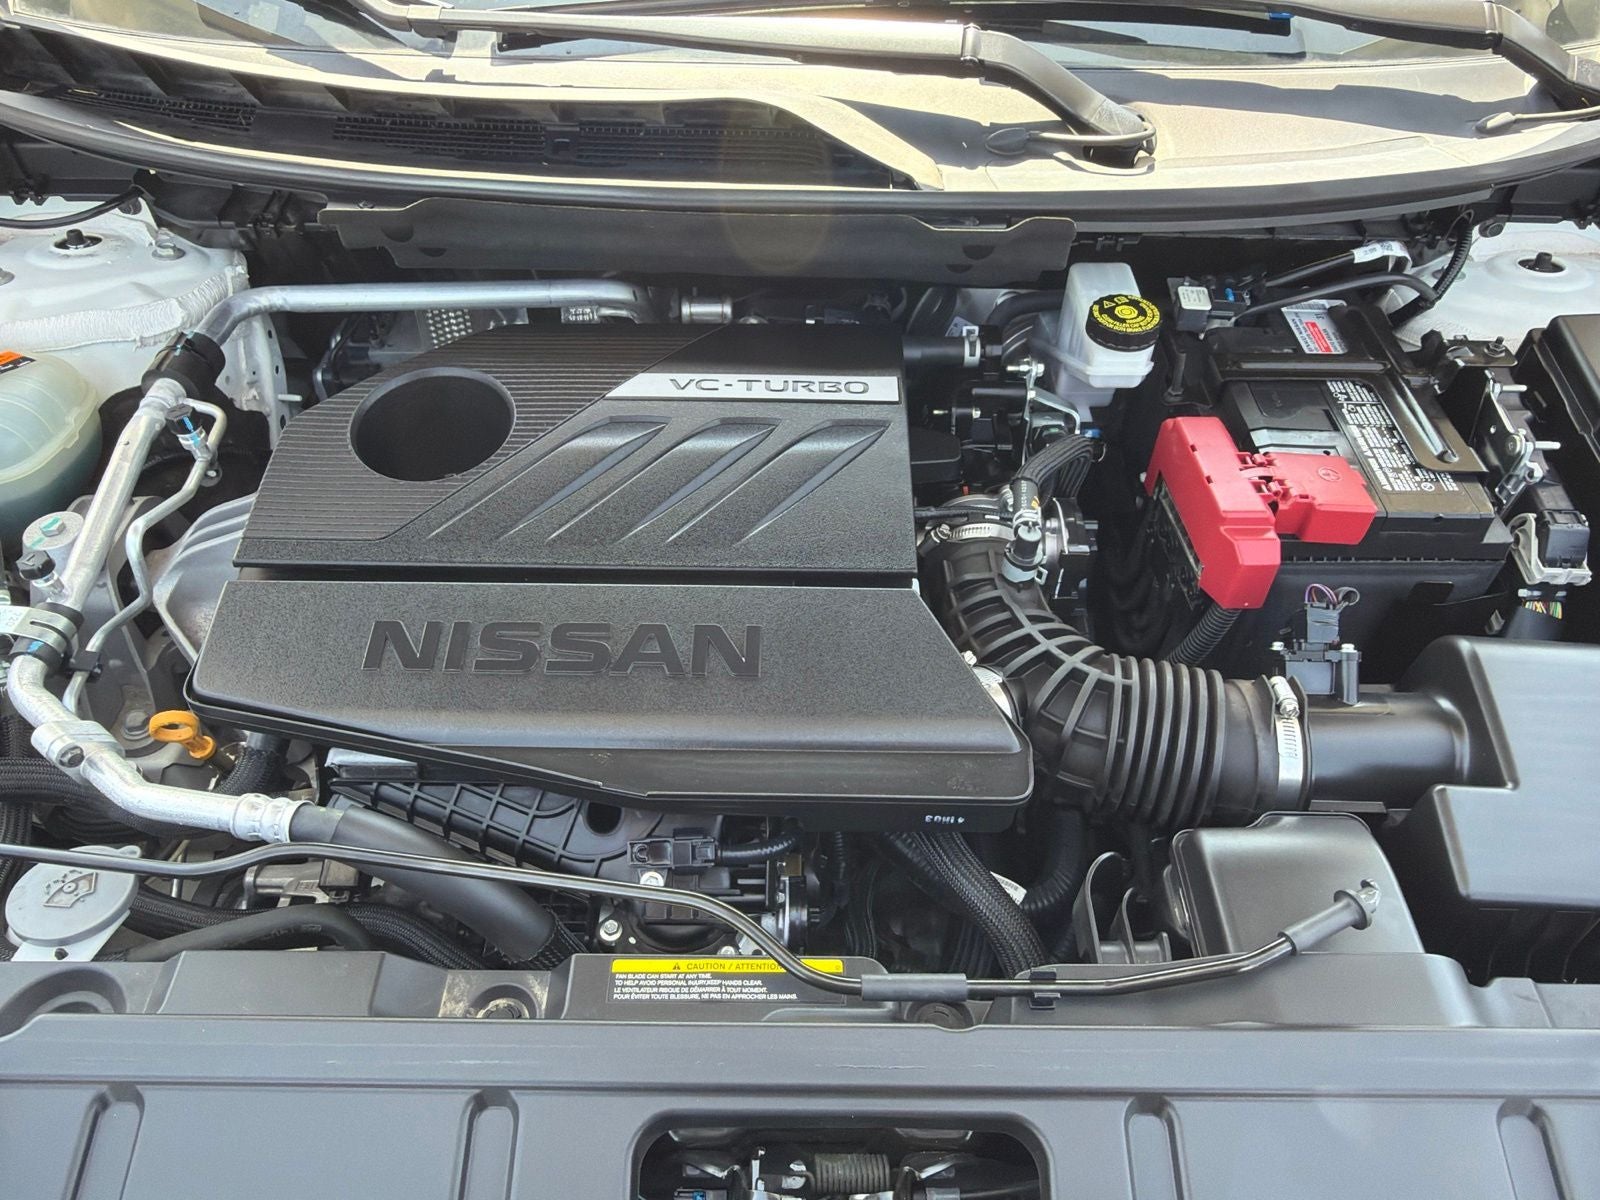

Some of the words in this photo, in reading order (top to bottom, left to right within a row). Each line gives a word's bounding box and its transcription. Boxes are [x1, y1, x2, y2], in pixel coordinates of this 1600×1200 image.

[669, 378, 870, 395] VC-TURBO
[361, 619, 762, 678] NISSAN
[686, 962, 726, 971] CAUTION
